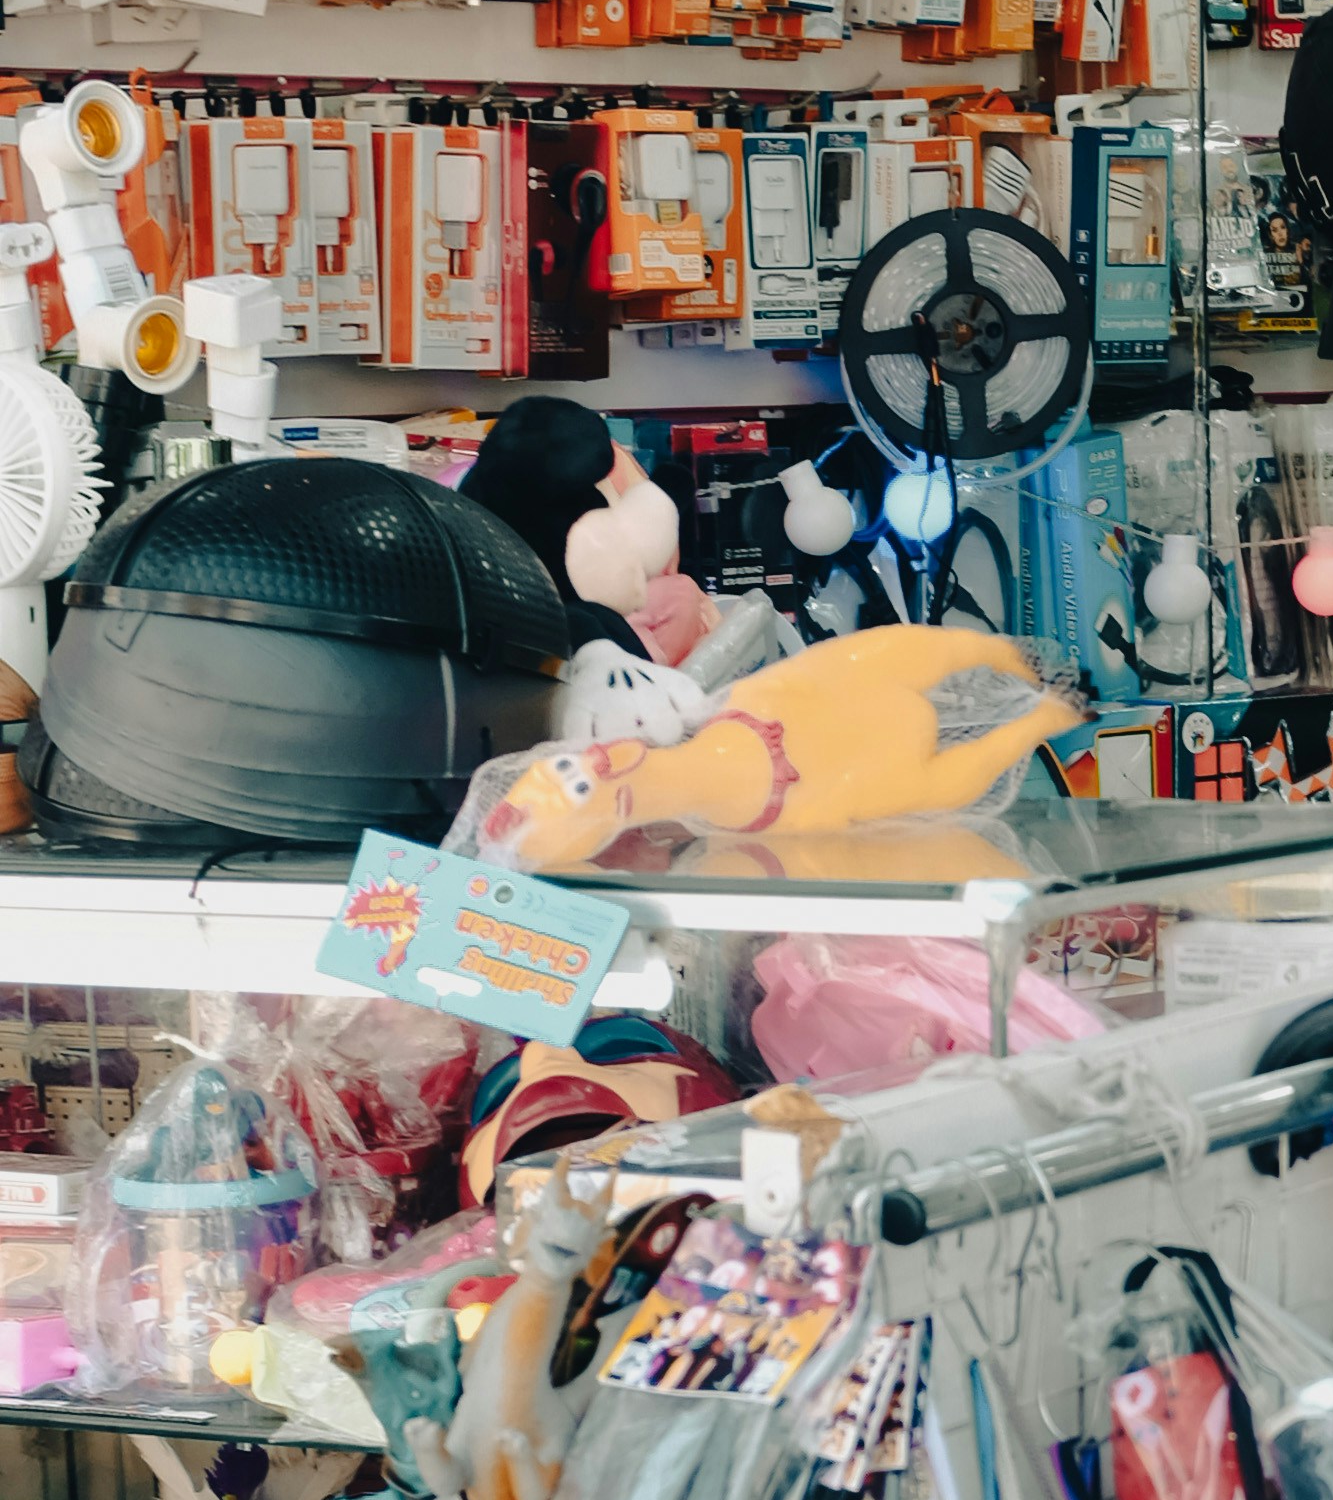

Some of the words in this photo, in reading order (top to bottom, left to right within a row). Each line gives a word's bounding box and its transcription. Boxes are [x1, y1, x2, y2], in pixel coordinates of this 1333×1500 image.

[1060, 540, 1074, 583] Audio
[1061, 584, 1075, 634] Video
[456, 907, 591, 978] Chicken
